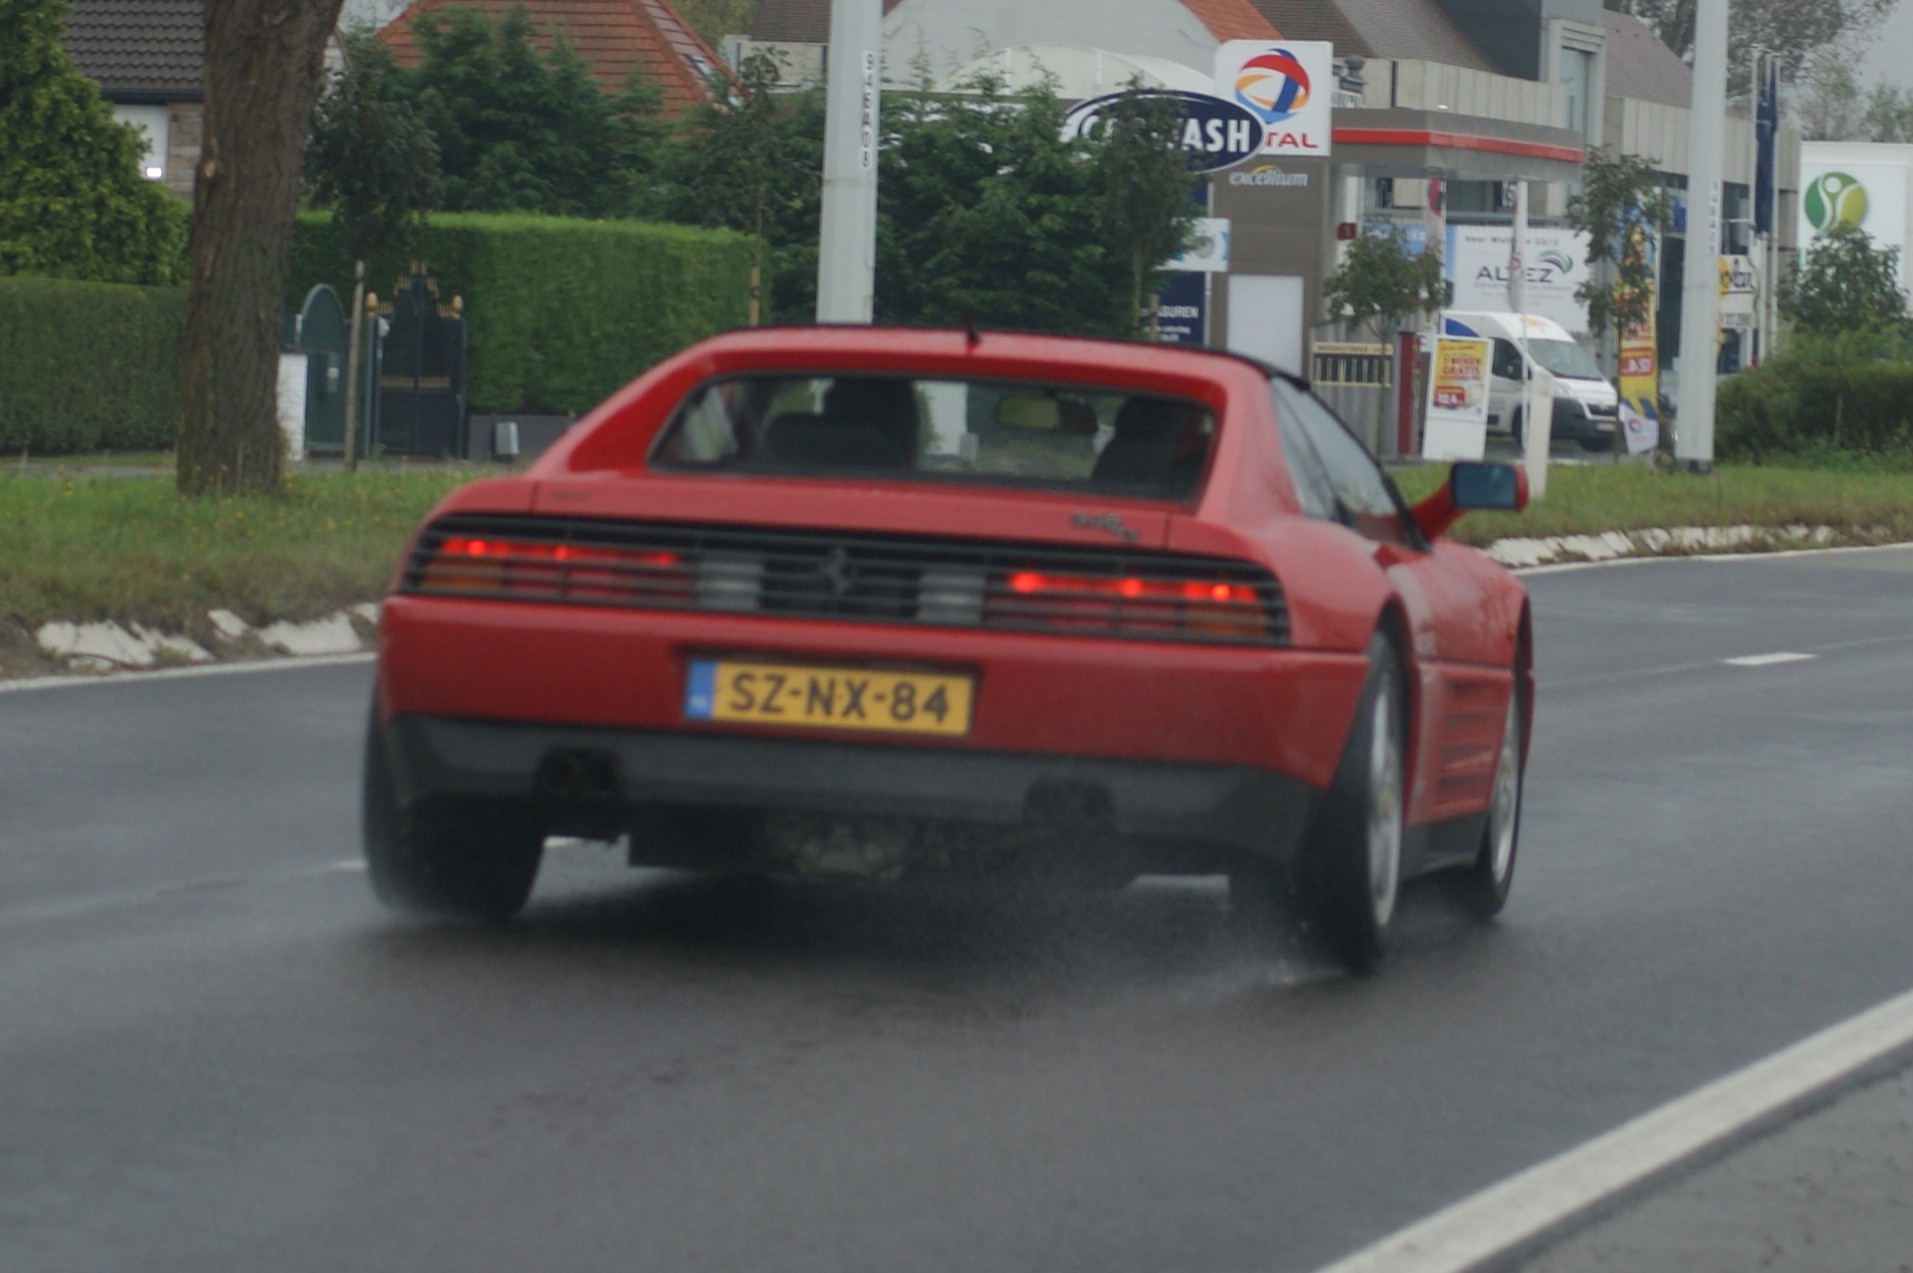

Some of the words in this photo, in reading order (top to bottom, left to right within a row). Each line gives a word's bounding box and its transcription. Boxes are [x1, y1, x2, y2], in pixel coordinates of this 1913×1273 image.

[1264, 132, 1318, 148] TAL
[1474, 264, 1553, 284] ALEZ
[729, 671, 949, 724] SZ-NX-84
